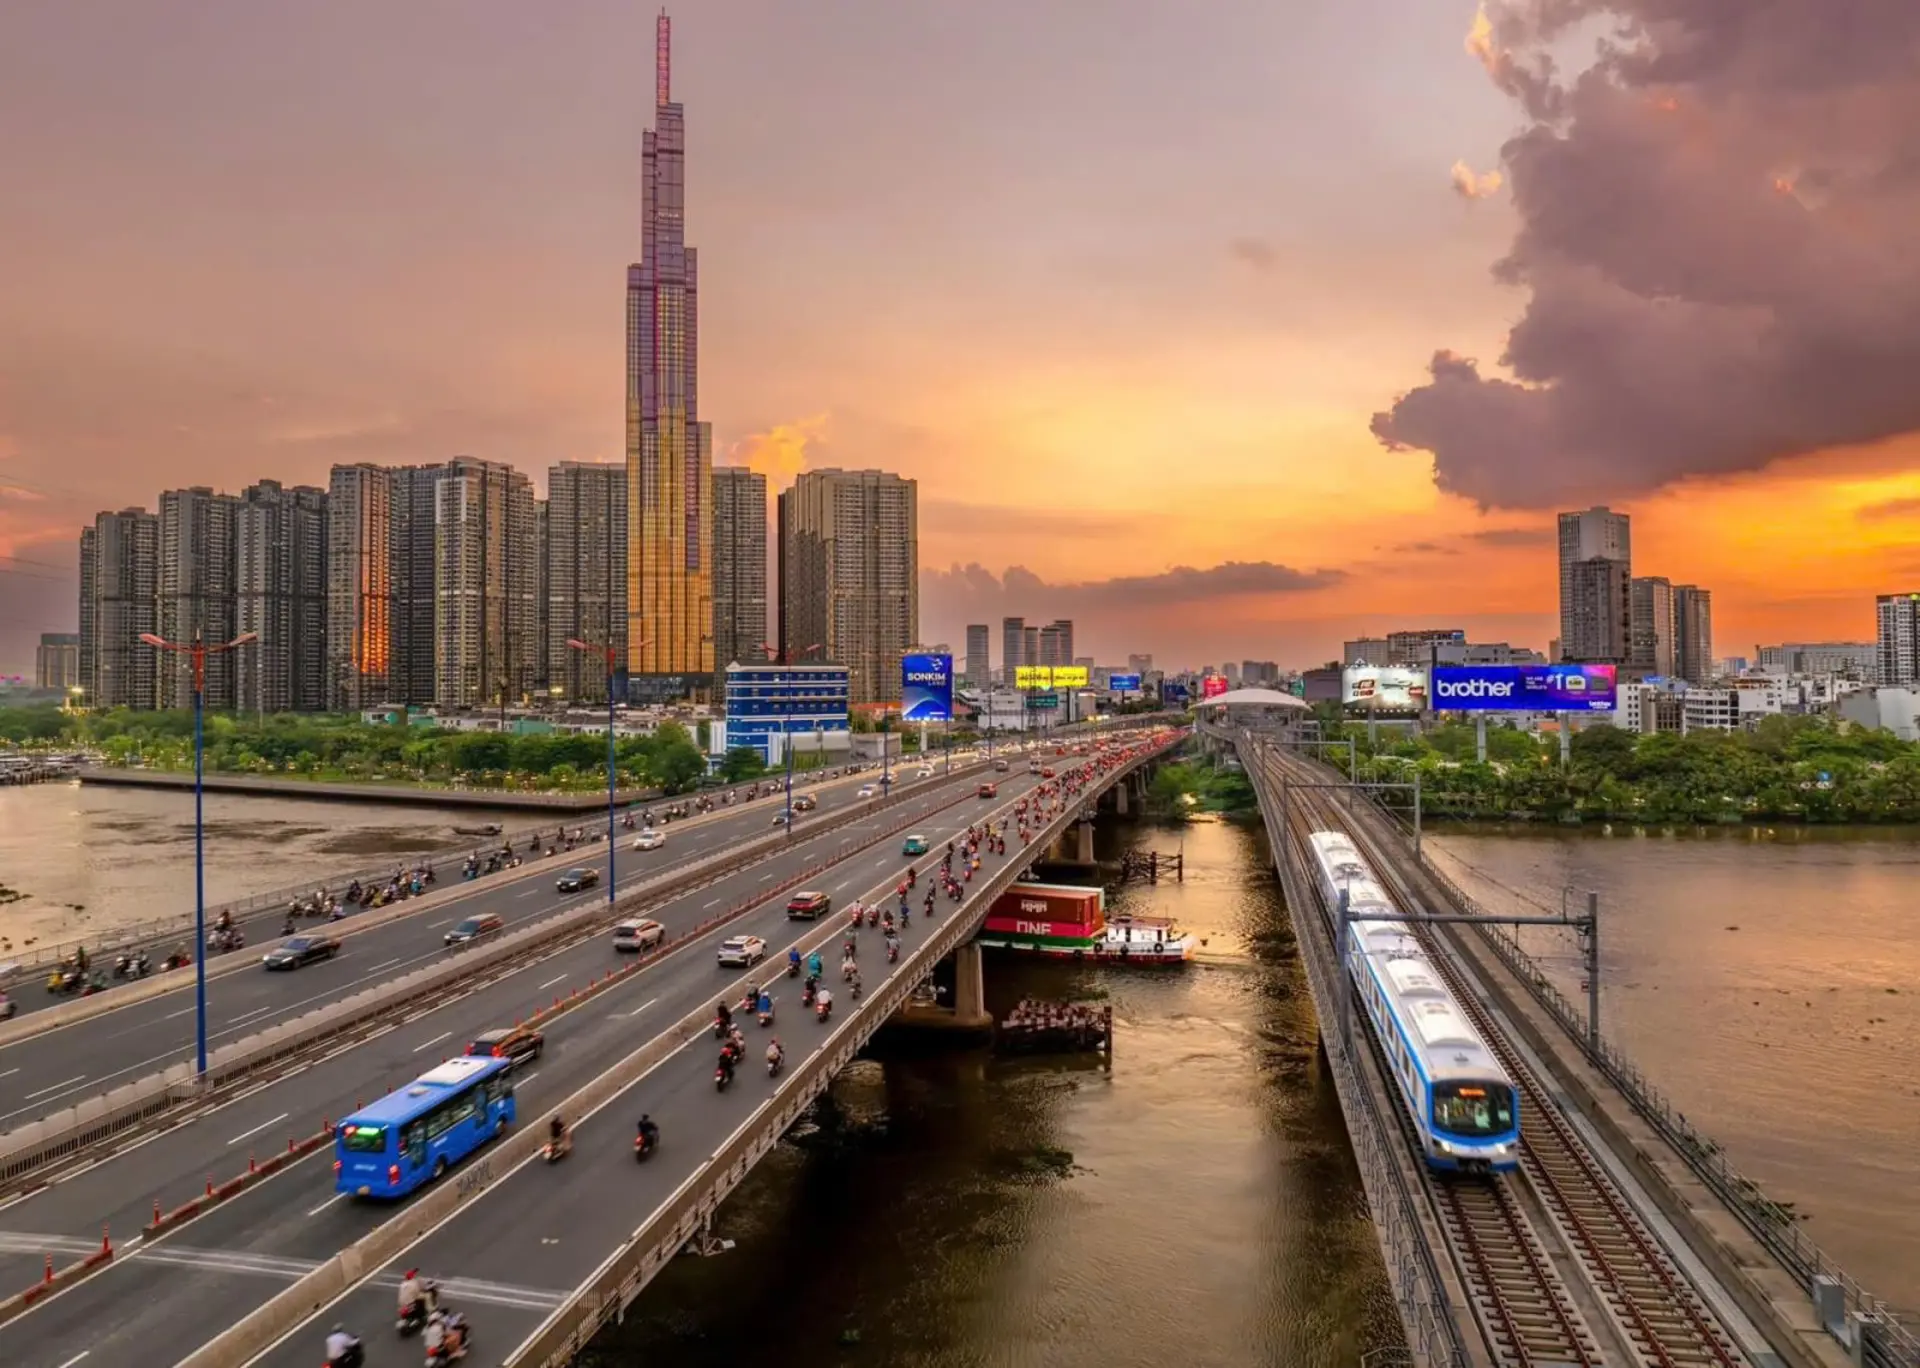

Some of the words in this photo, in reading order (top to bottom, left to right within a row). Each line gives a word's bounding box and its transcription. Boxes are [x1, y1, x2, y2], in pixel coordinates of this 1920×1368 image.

[907, 672, 946, 682] SONKIM
[1546, 673, 1564, 690] #1
[1437, 679, 1515, 697] brother
